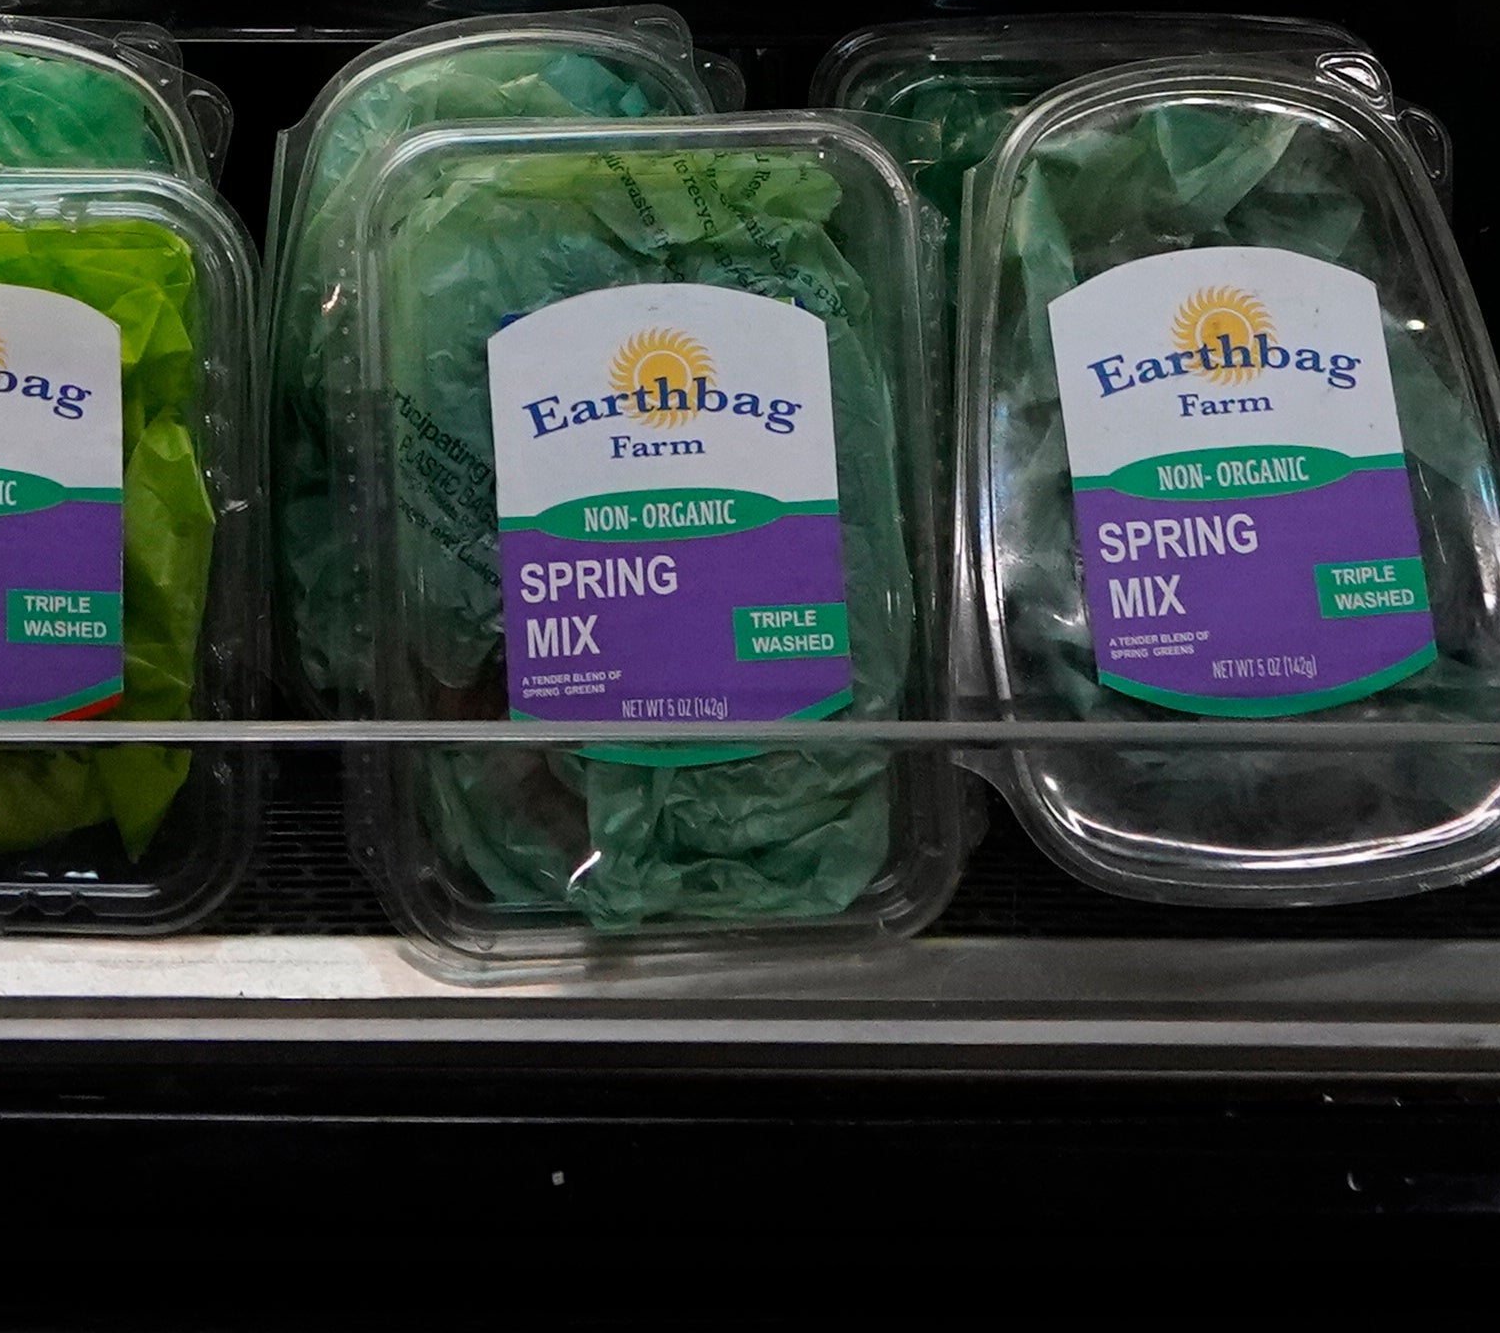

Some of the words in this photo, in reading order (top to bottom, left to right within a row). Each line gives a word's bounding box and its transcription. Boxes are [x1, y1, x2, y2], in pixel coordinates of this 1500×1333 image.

[1087, 333, 1361, 398] Earthbag
[522, 376, 802, 438] Earthbag
[1178, 394, 1274, 417] Farm
[610, 436, 706, 459] Farm
[1216, 457, 1309, 486] ORGANIC
[643, 500, 736, 528] ORGANIC
[1099, 513, 1258, 563] SPRING
[520, 554, 677, 604] SPRING
[1331, 565, 1396, 586] TRIPLE
[23, 596, 90, 613] TRIPLE
[1109, 575, 1186, 619] MIX
[1334, 589, 1415, 611] WASHED
[23, 620, 107, 638] WASHED
[750, 610, 817, 629] TRIPLE
[526, 615, 600, 658] MIX
[752, 634, 834, 653] WASHED
[1118, 634, 1158, 646] TENDER
[1161, 632, 1194, 643] BLEND
[1111, 648, 1148, 659] SPRING
[1153, 645, 1194, 656] GREENS
[531, 674, 570, 685] TENDER
[573, 672, 605, 682] BLEND
[1213, 660, 1234, 679] NET
[1237, 659, 1254, 678] WT
[1257, 658, 1265, 677] 5
[1268, 657, 1282, 676] OZ
[522, 687, 560, 698] SPRING
[565, 684, 605, 695] GREENS
[622, 699, 643, 717] NET
[646, 698, 664, 717] WT
[667, 698, 675, 716] 5
[678, 698, 692, 716] OZ
